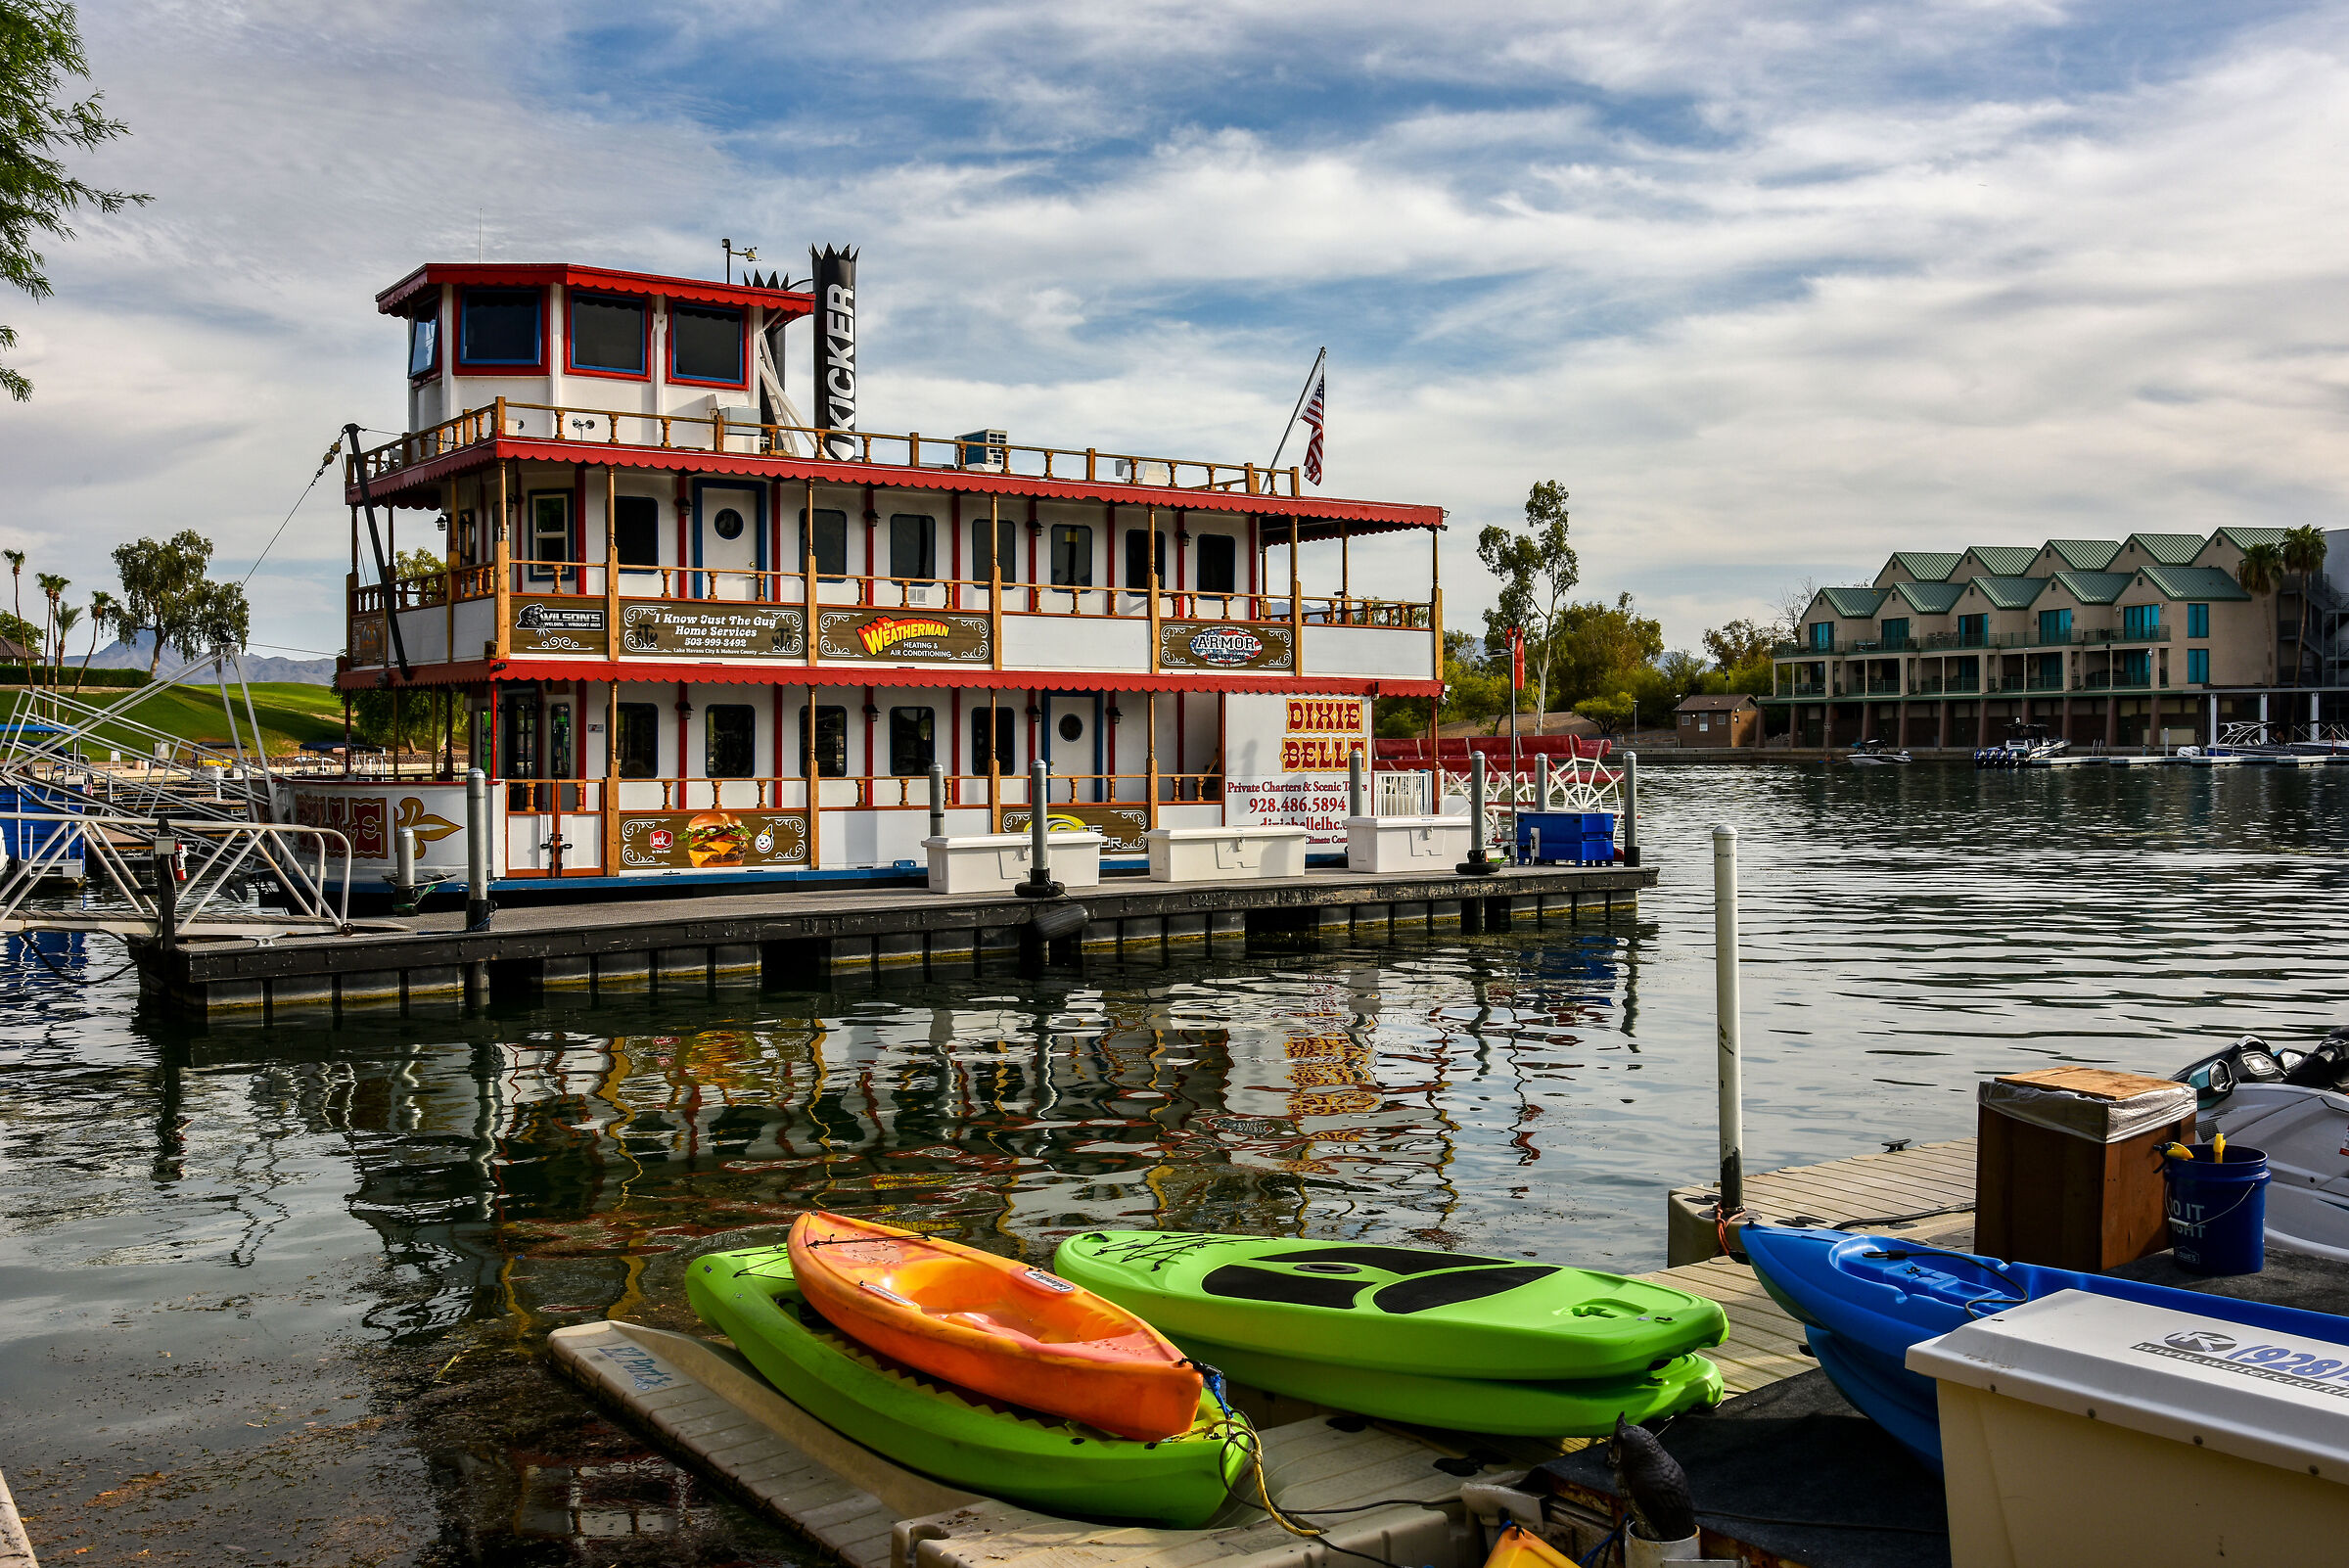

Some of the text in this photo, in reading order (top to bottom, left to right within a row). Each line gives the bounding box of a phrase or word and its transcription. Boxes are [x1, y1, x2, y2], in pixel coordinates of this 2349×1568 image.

[827, 283, 856, 439] KICKER
[539, 613, 601, 622] WILSON'S
[654, 613, 777, 628] I Know Just The Guy
[674, 625, 758, 637] Home Services
[684, 637, 747, 647] 503-999-3492
[863, 623, 949, 656] WEATHERMAN
[1197, 636, 1256, 650] ARMOR
[1286, 698, 1362, 733] DIXIE
[1227, 782, 1261, 793] Private
[1262, 782, 1302, 793] Charters
[1303, 782, 1313, 793] &
[1313, 781, 1342, 792] Scenic
[1249, 796, 1347, 813] 928.486.5894
[651, 832, 671, 846] Jack
[2186, 1202, 2205, 1221] IT
